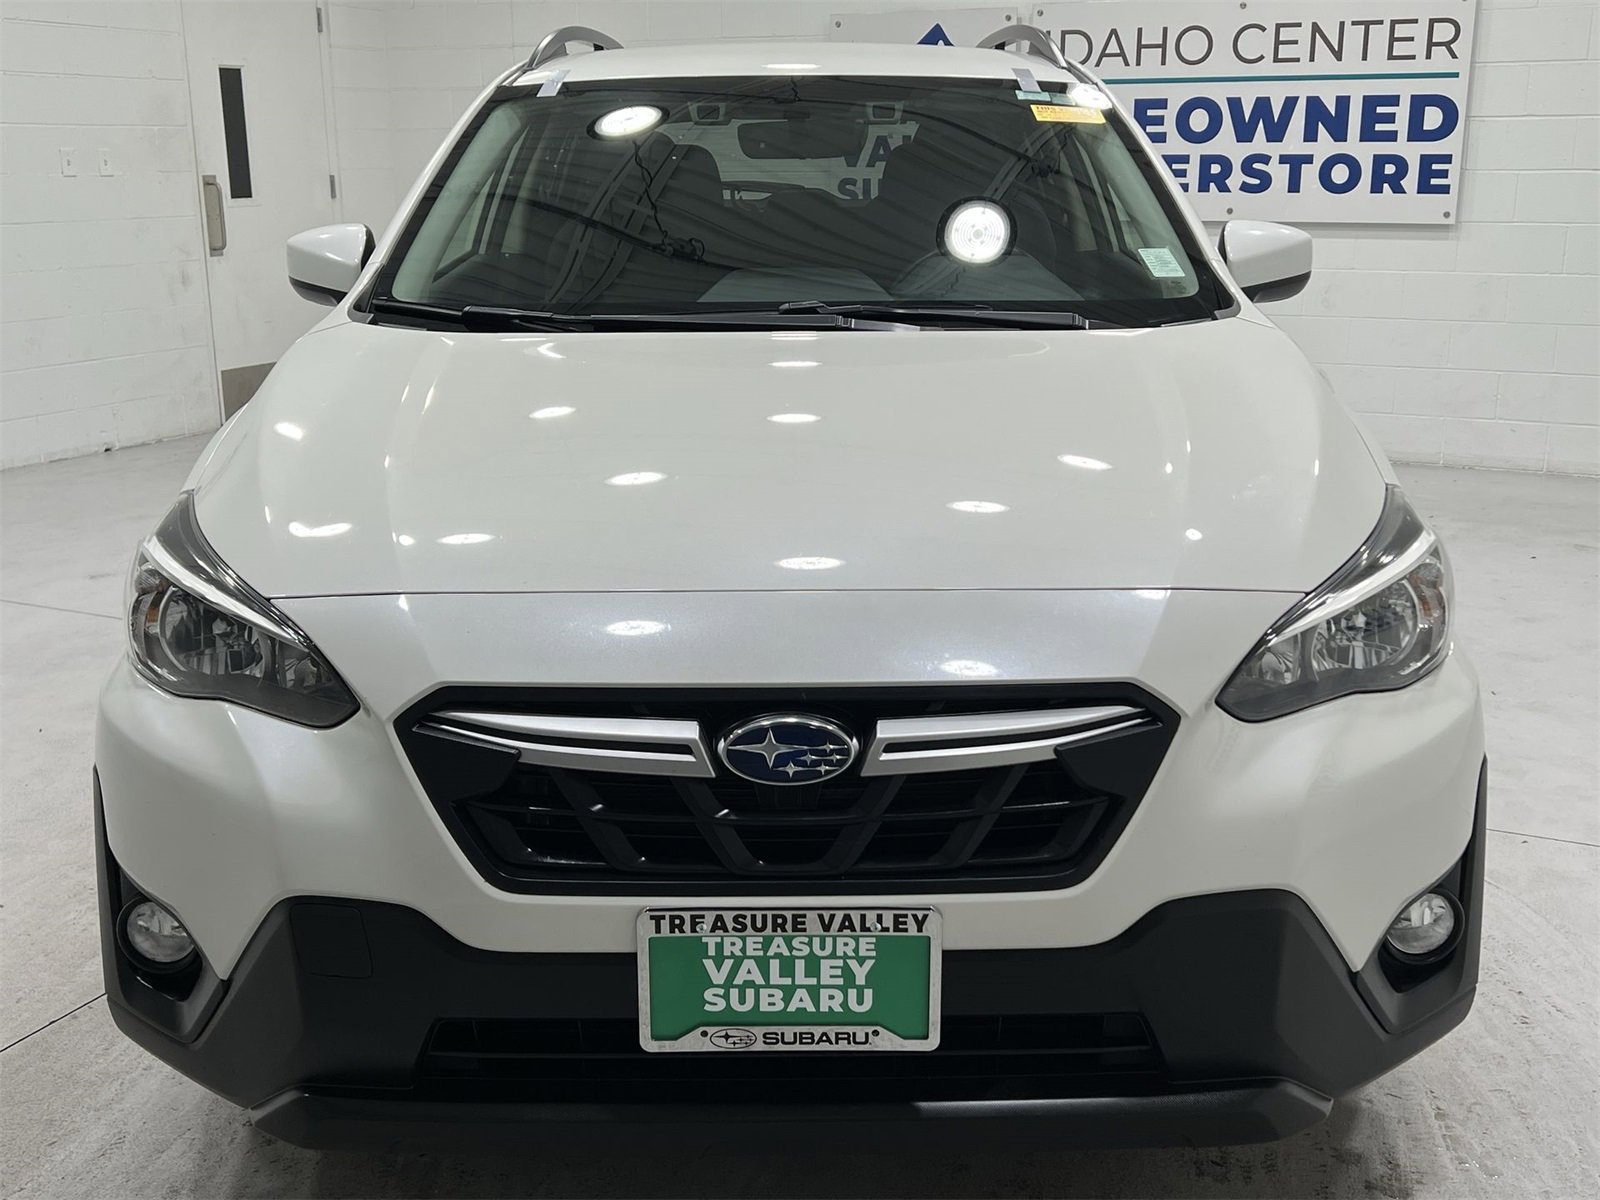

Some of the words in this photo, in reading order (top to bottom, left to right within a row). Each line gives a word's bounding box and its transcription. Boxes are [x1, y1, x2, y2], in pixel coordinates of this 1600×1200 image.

[1046, 25, 1213, 67] DAHO
[1232, 17, 1462, 64] CENTER
[1134, 94, 1459, 143] EOWNED
[649, 913, 807, 934] TREASURE
[817, 913, 930, 933] VALLEY
[702, 937, 877, 957] TREASURE
[702, 959, 876, 985] VALLEY
[703, 988, 873, 1013] SUBARU
[762, 1031, 870, 1046] SUBARU
